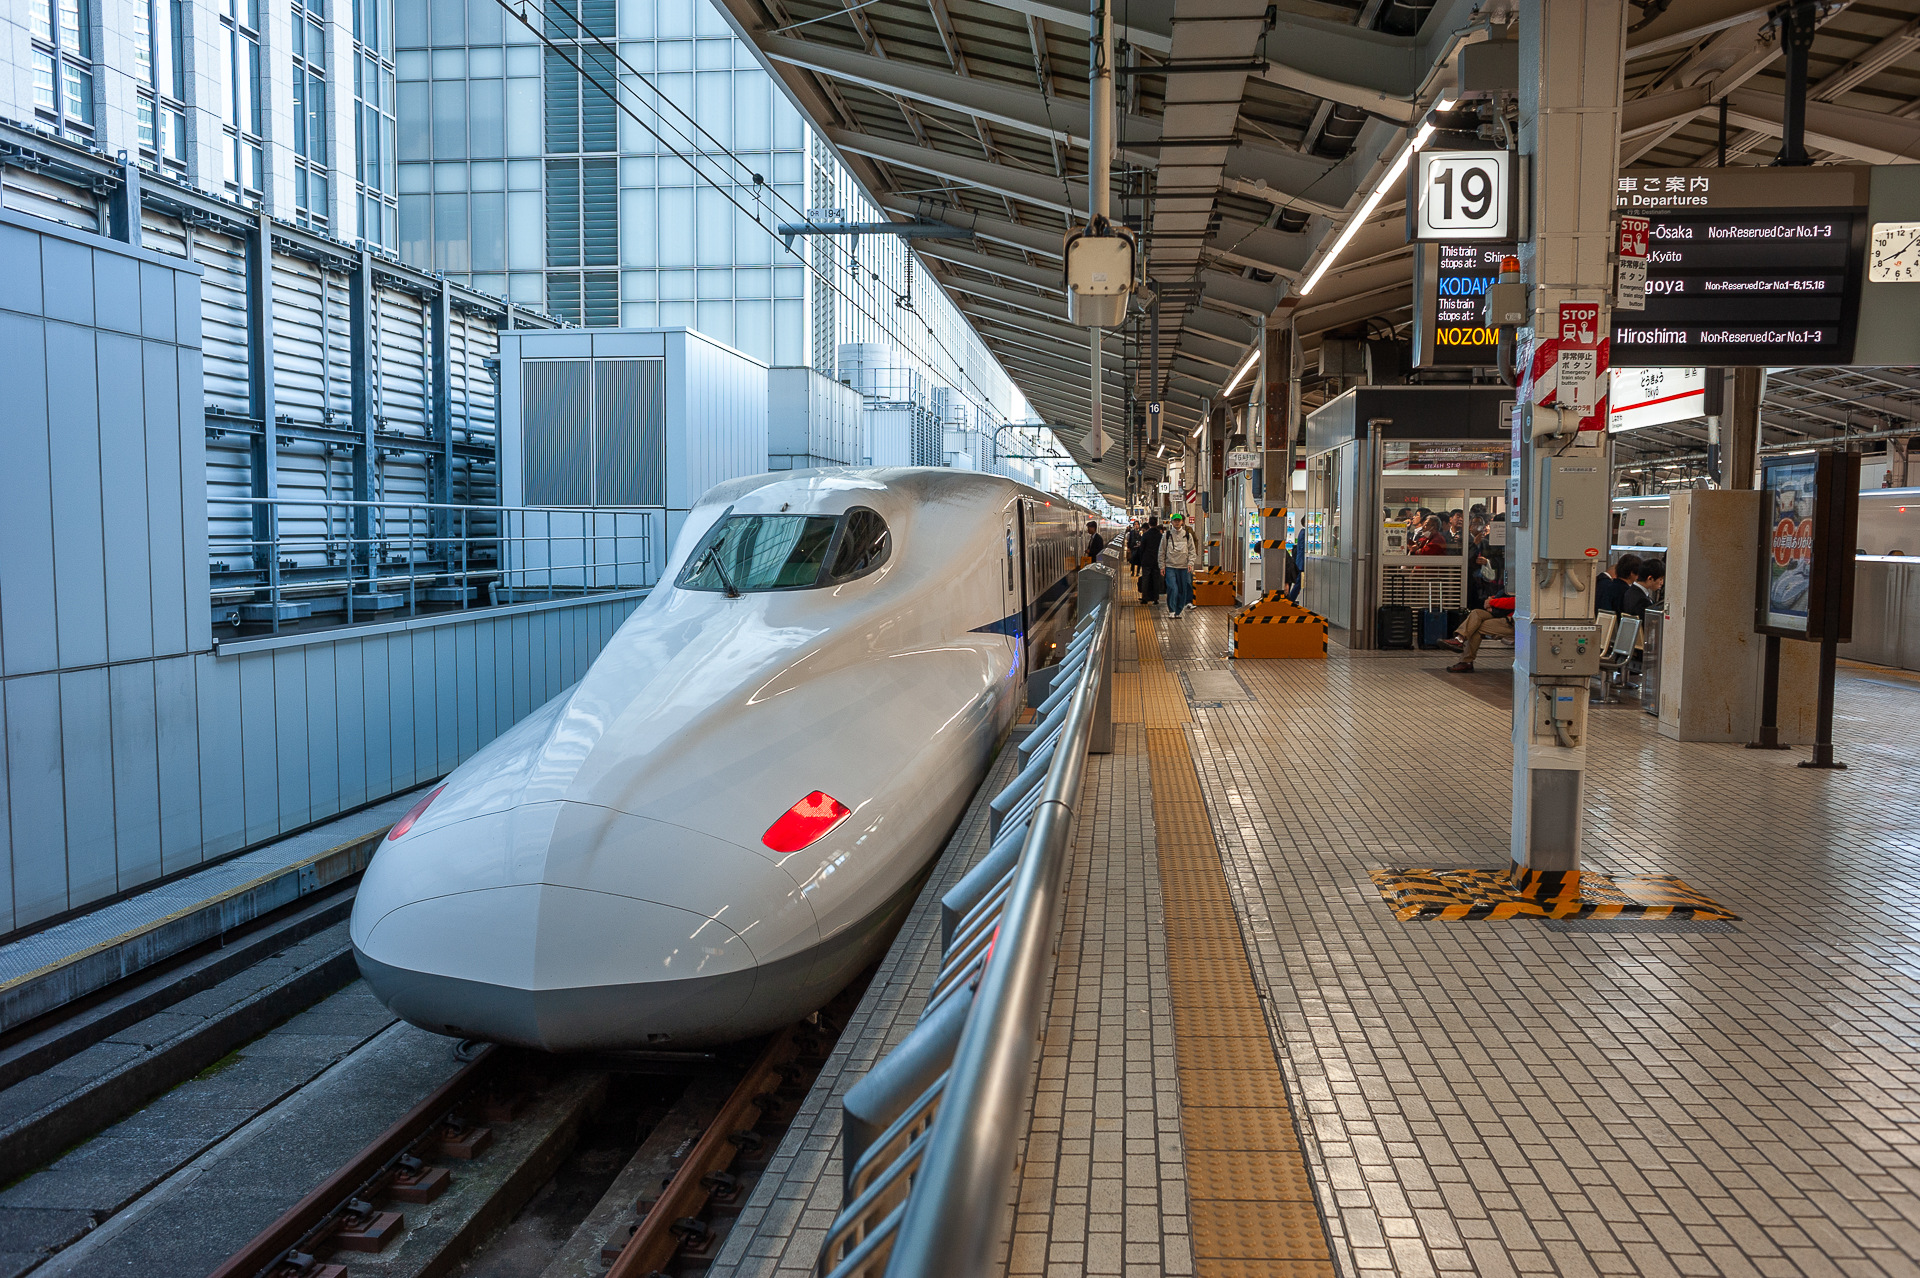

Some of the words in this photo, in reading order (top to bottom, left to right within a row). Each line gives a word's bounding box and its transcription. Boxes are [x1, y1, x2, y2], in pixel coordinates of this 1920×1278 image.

[1617, 176, 1709, 193] 車ご案内
[1434, 167, 1492, 220] 19
[1632, 194, 1708, 208] Departures
[1621, 220, 1649, 232] STOP
[1648, 224, 1693, 239] -Ōsaka
[1708, 226, 1777, 238] Non-Reserved
[1777, 226, 1796, 237] Car
[1886, 232, 1894, 240] 11
[1897, 229, 1906, 237] 12
[1879, 239, 1887, 247] 10
[1440, 246, 1459, 257] This
[1458, 246, 1478, 257] train
[1875, 250, 1881, 258] 9
[1440, 258, 1463, 270] stops
[1464, 258, 1477, 268] at:
[1620, 260, 1646, 270] 非常停止
[1877, 260, 1883, 268] 8
[1913, 259, 1919, 267] 4
[1884, 267, 1891, 275] 7
[1894, 269, 1901, 278] 6
[1905, 267, 1912, 275] 5
[1619, 271, 1645, 282] ボタン
[1439, 277, 1500, 296] KODAM
[1620, 283, 1644, 292] Emergency
[1644, 280, 1685, 295] goya
[1705, 281, 1759, 290] Non-Reserved
[1758, 281, 1773, 290] Car
[1438, 298, 1456, 309] This
[1456, 298, 1475, 309] train
[1438, 310, 1461, 322] stops
[1462, 310, 1474, 321] at:
[1561, 310, 1597, 320] STOP
[1616, 328, 1687, 344] Hiroshima
[1700, 331, 1768, 343] Non-Reserved
[1768, 331, 1787, 342] Car
[1562, 352, 1593, 361] 非常停止
[1562, 361, 1592, 370] ボタン
[1640, 371, 1664, 388] とうきょう
[1149, 403, 1160, 413] 16
